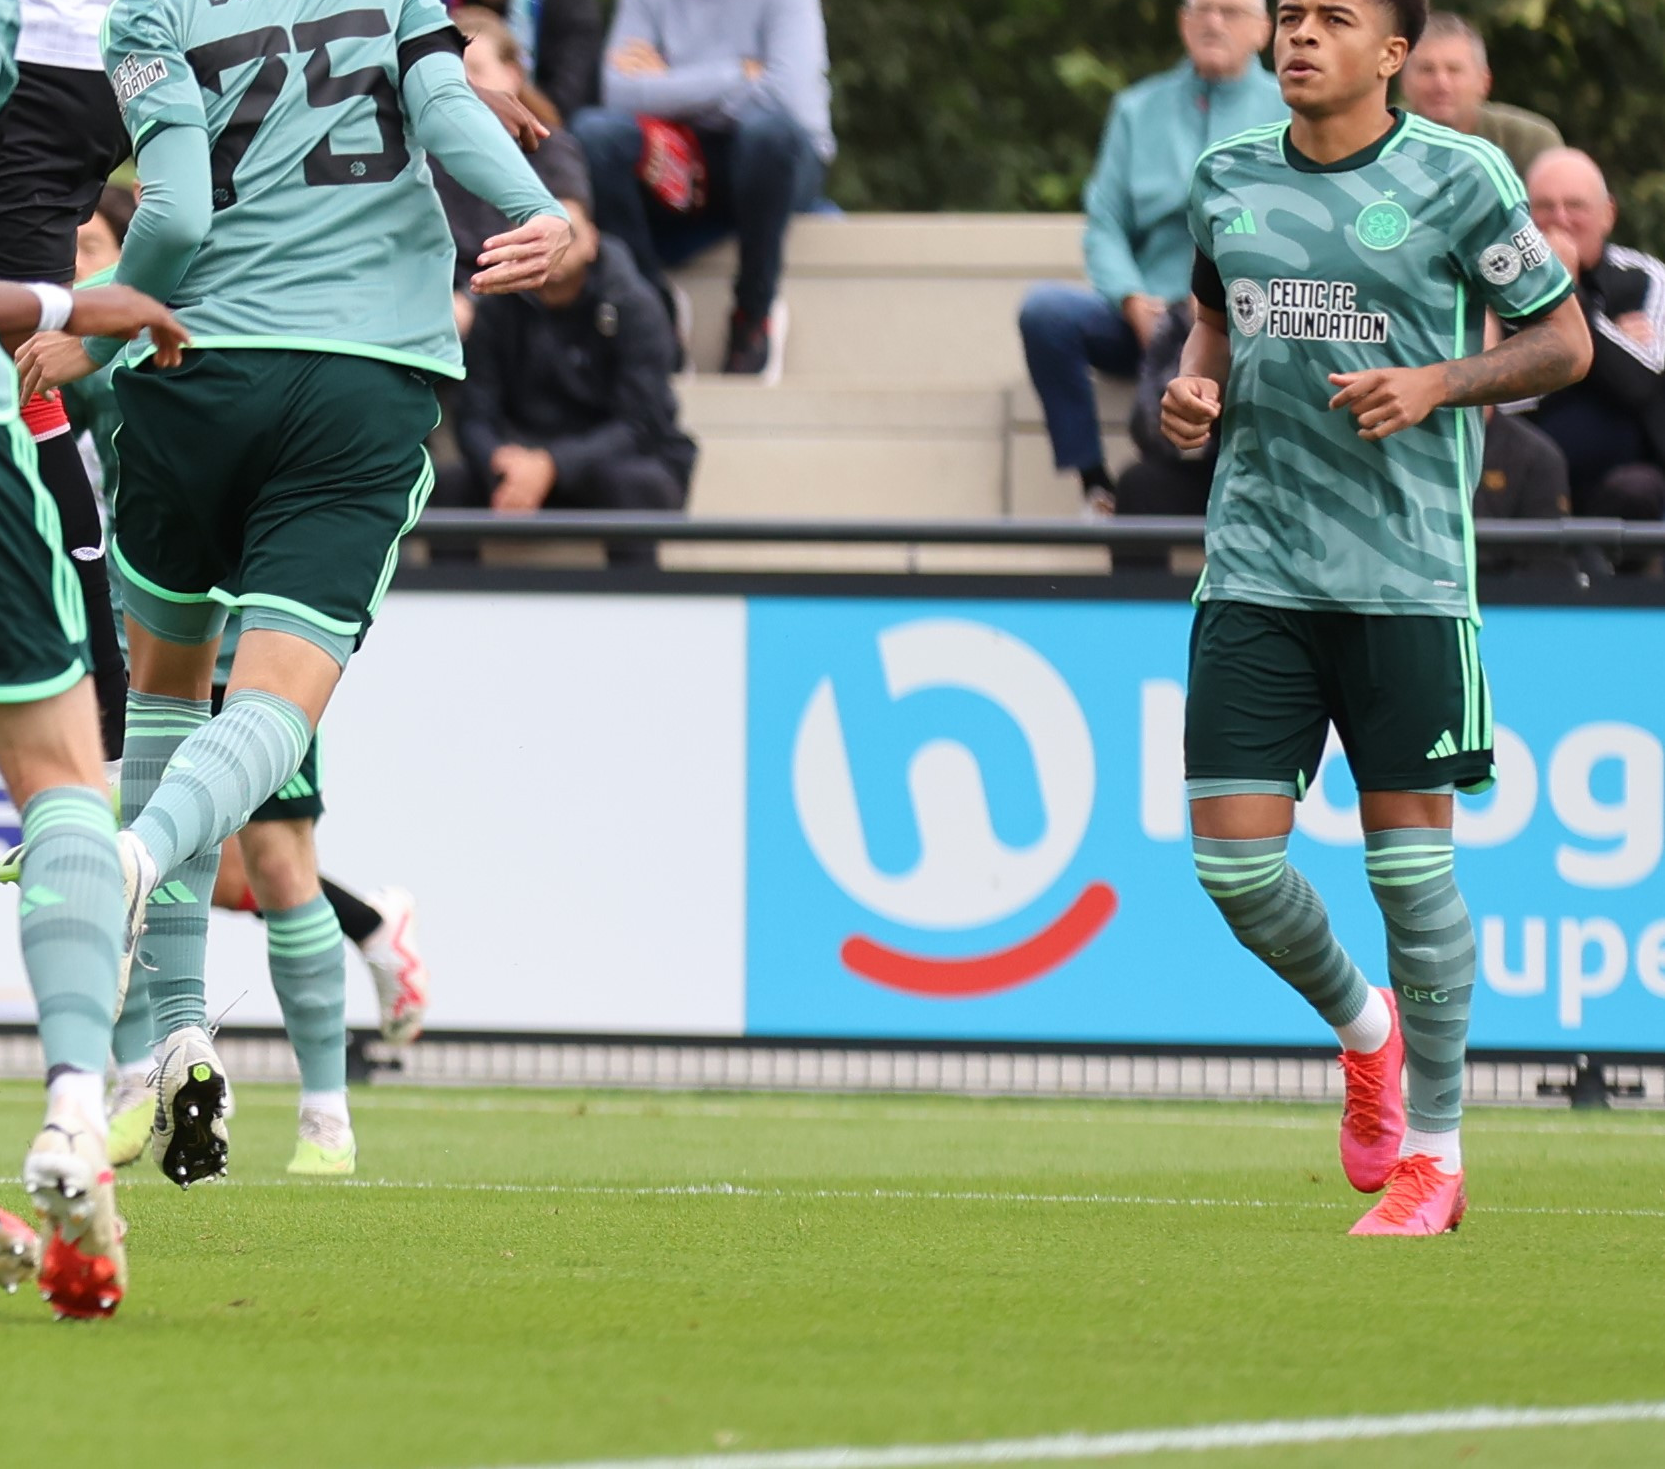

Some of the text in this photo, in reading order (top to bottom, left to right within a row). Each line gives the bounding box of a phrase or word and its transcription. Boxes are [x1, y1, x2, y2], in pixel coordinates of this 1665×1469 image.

[183, 8, 412, 212] 75
[1270, 281, 1326, 309] CELTIC
[1332, 284, 1354, 311] FC
[1269, 310, 1386, 342] FOUNDATION
